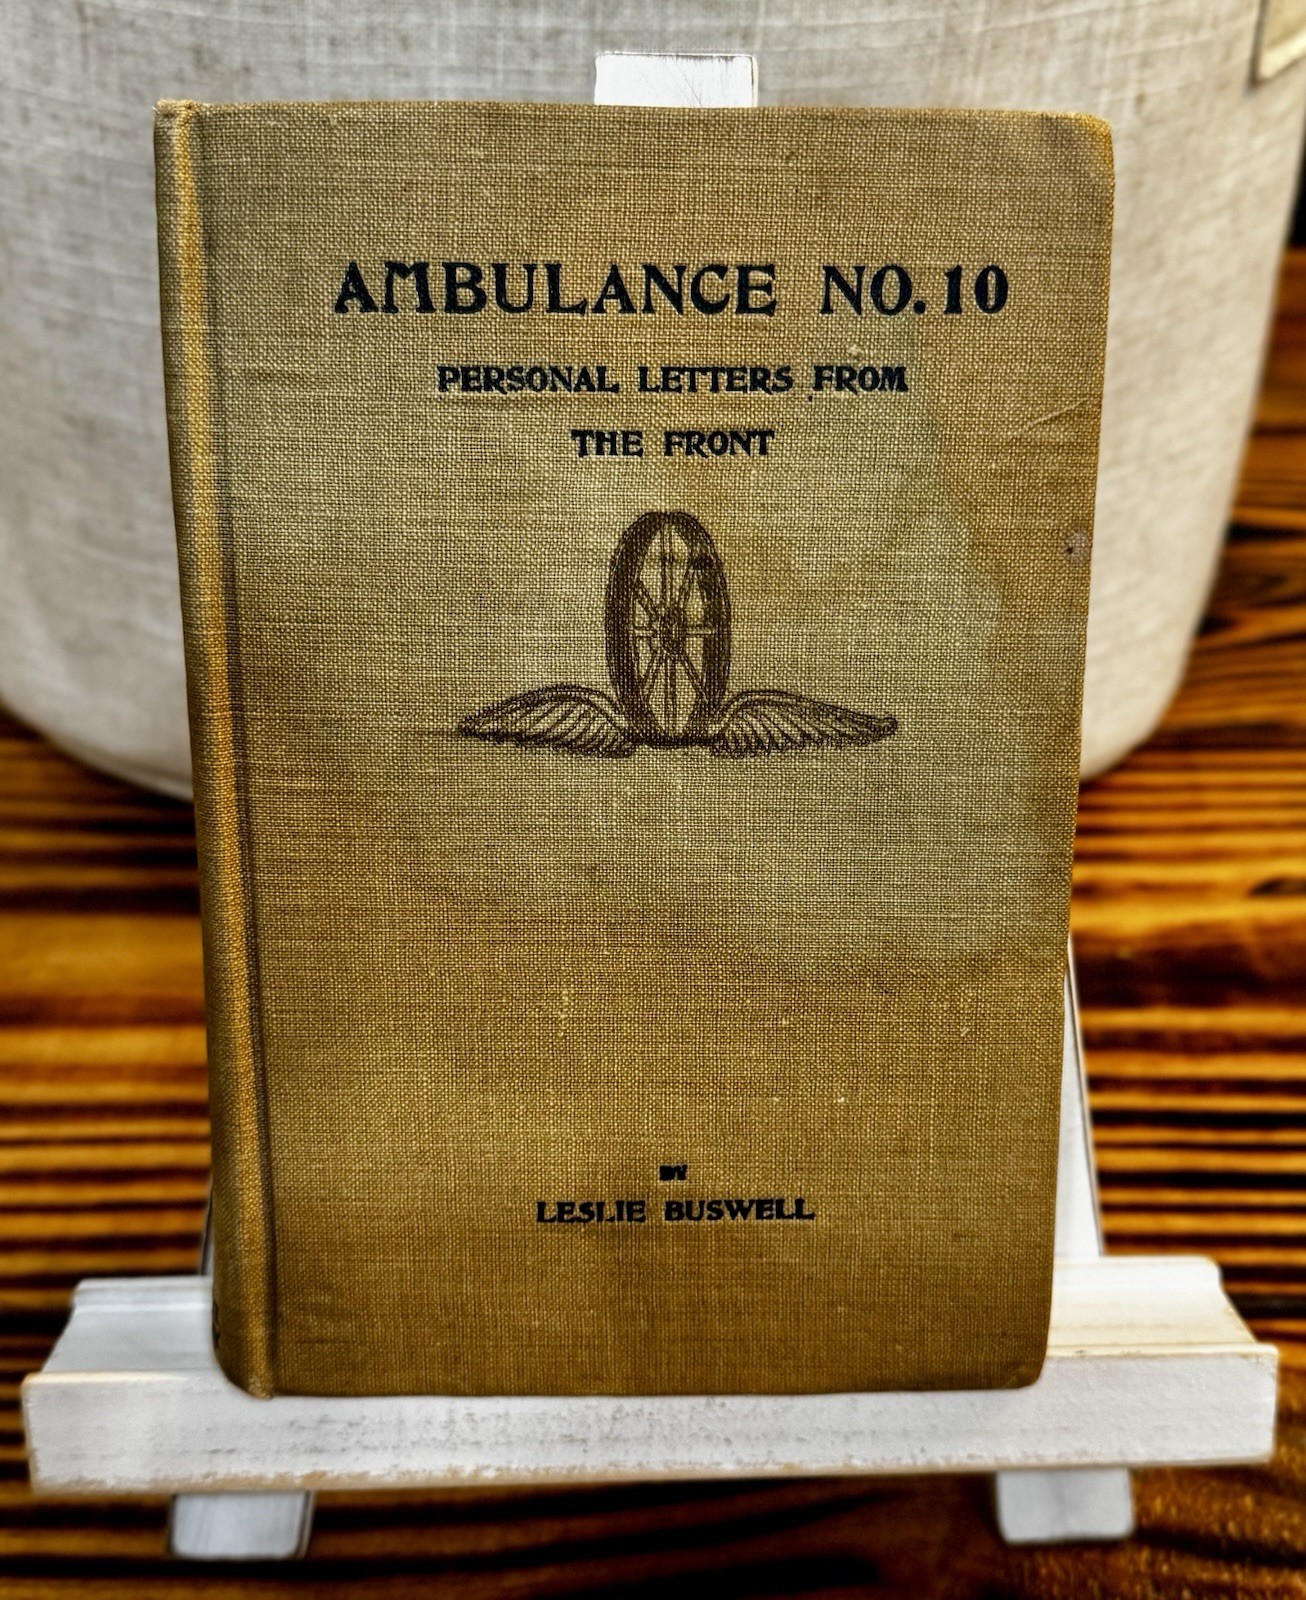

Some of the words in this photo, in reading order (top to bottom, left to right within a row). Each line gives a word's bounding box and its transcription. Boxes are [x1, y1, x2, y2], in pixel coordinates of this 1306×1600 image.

[334, 260, 778, 317] AMBULANCE
[436, 364, 620, 395] PERSONAL
[637, 364, 795, 396] LETTERS
[812, 364, 909, 396] FROM
[570, 429, 644, 458] THE
[663, 428, 775, 459] FRONT
[536, 1200, 646, 1224] LESLIE
[664, 1197, 816, 1223] BUSWELL
